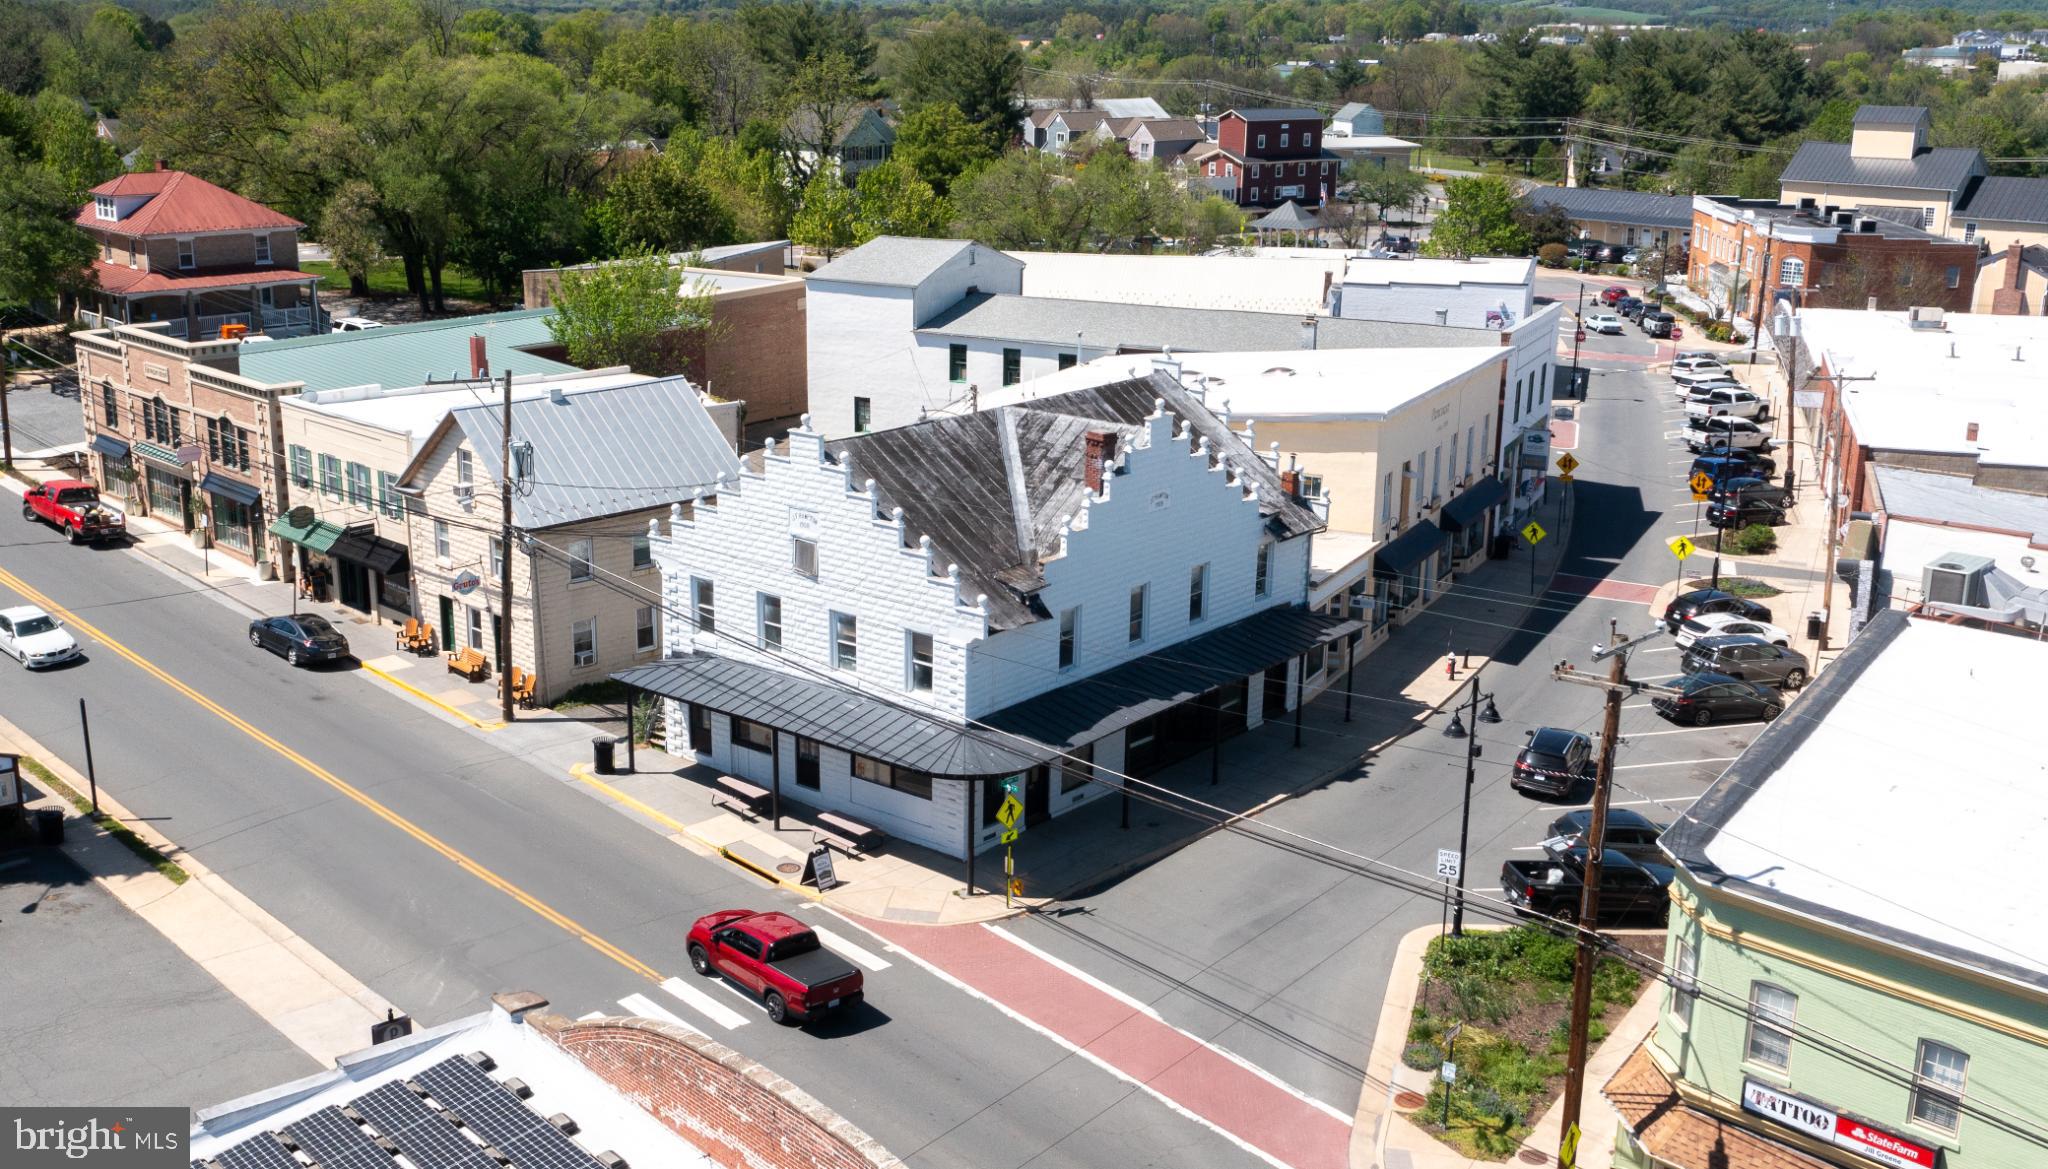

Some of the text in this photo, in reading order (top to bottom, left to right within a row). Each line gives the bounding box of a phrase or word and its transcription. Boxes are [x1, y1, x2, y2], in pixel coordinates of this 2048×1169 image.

[1439, 851, 1459, 860] SPEED
[1440, 857, 1456, 865] LIMIT
[1438, 863, 1457, 876] 25
[1751, 1089, 1829, 1131] TATTOO
[1864, 1146, 1903, 1165] Jill Greene
